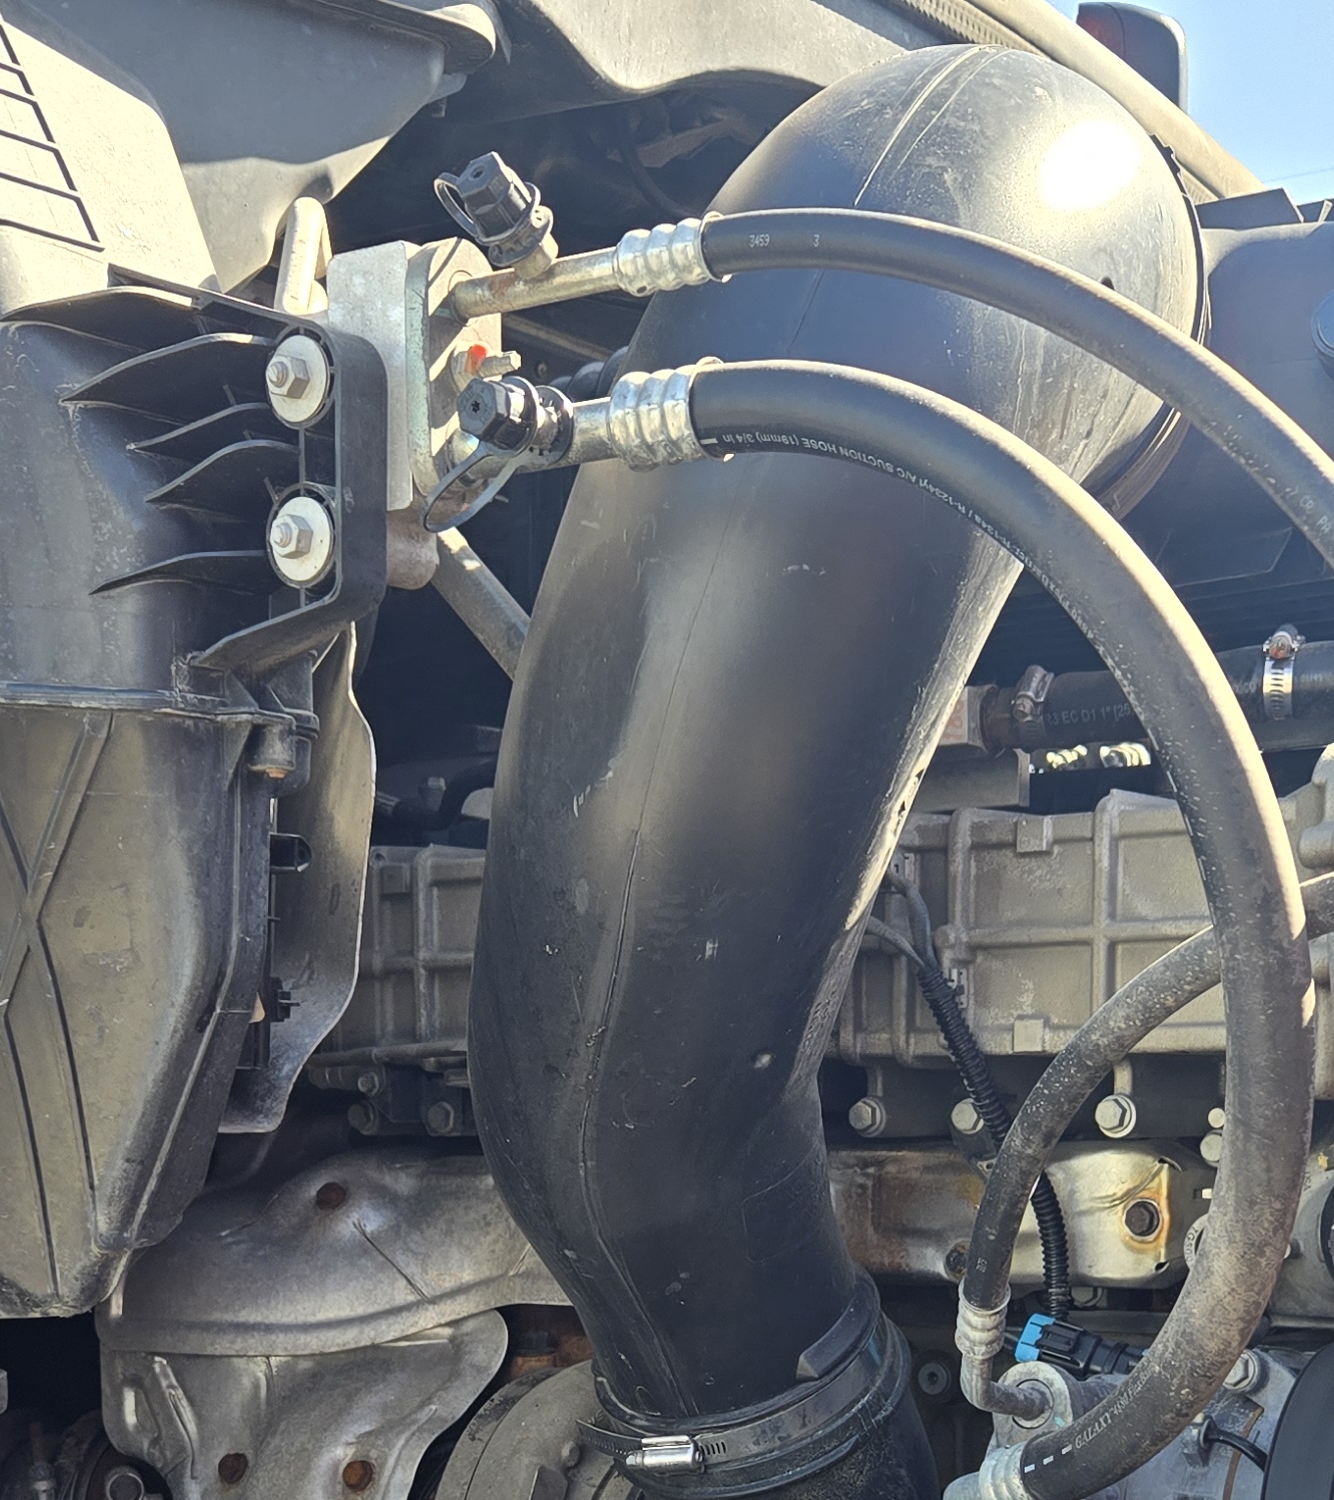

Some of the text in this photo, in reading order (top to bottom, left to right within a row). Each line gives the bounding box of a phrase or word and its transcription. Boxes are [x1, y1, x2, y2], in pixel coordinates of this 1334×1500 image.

[748, 233, 820, 248] 3459 3
[722, 434, 735, 444] in
[736, 432, 754, 444] 3/4
[756, 431, 800, 446] (19mm)
[802, 437, 837, 454] HOSE
[839, 446, 894, 474] SUCTION
[896, 466, 917, 483] A/C
[1061, 709, 1079, 724] EC
[1074, 1412, 1112, 1449] GALAXY
